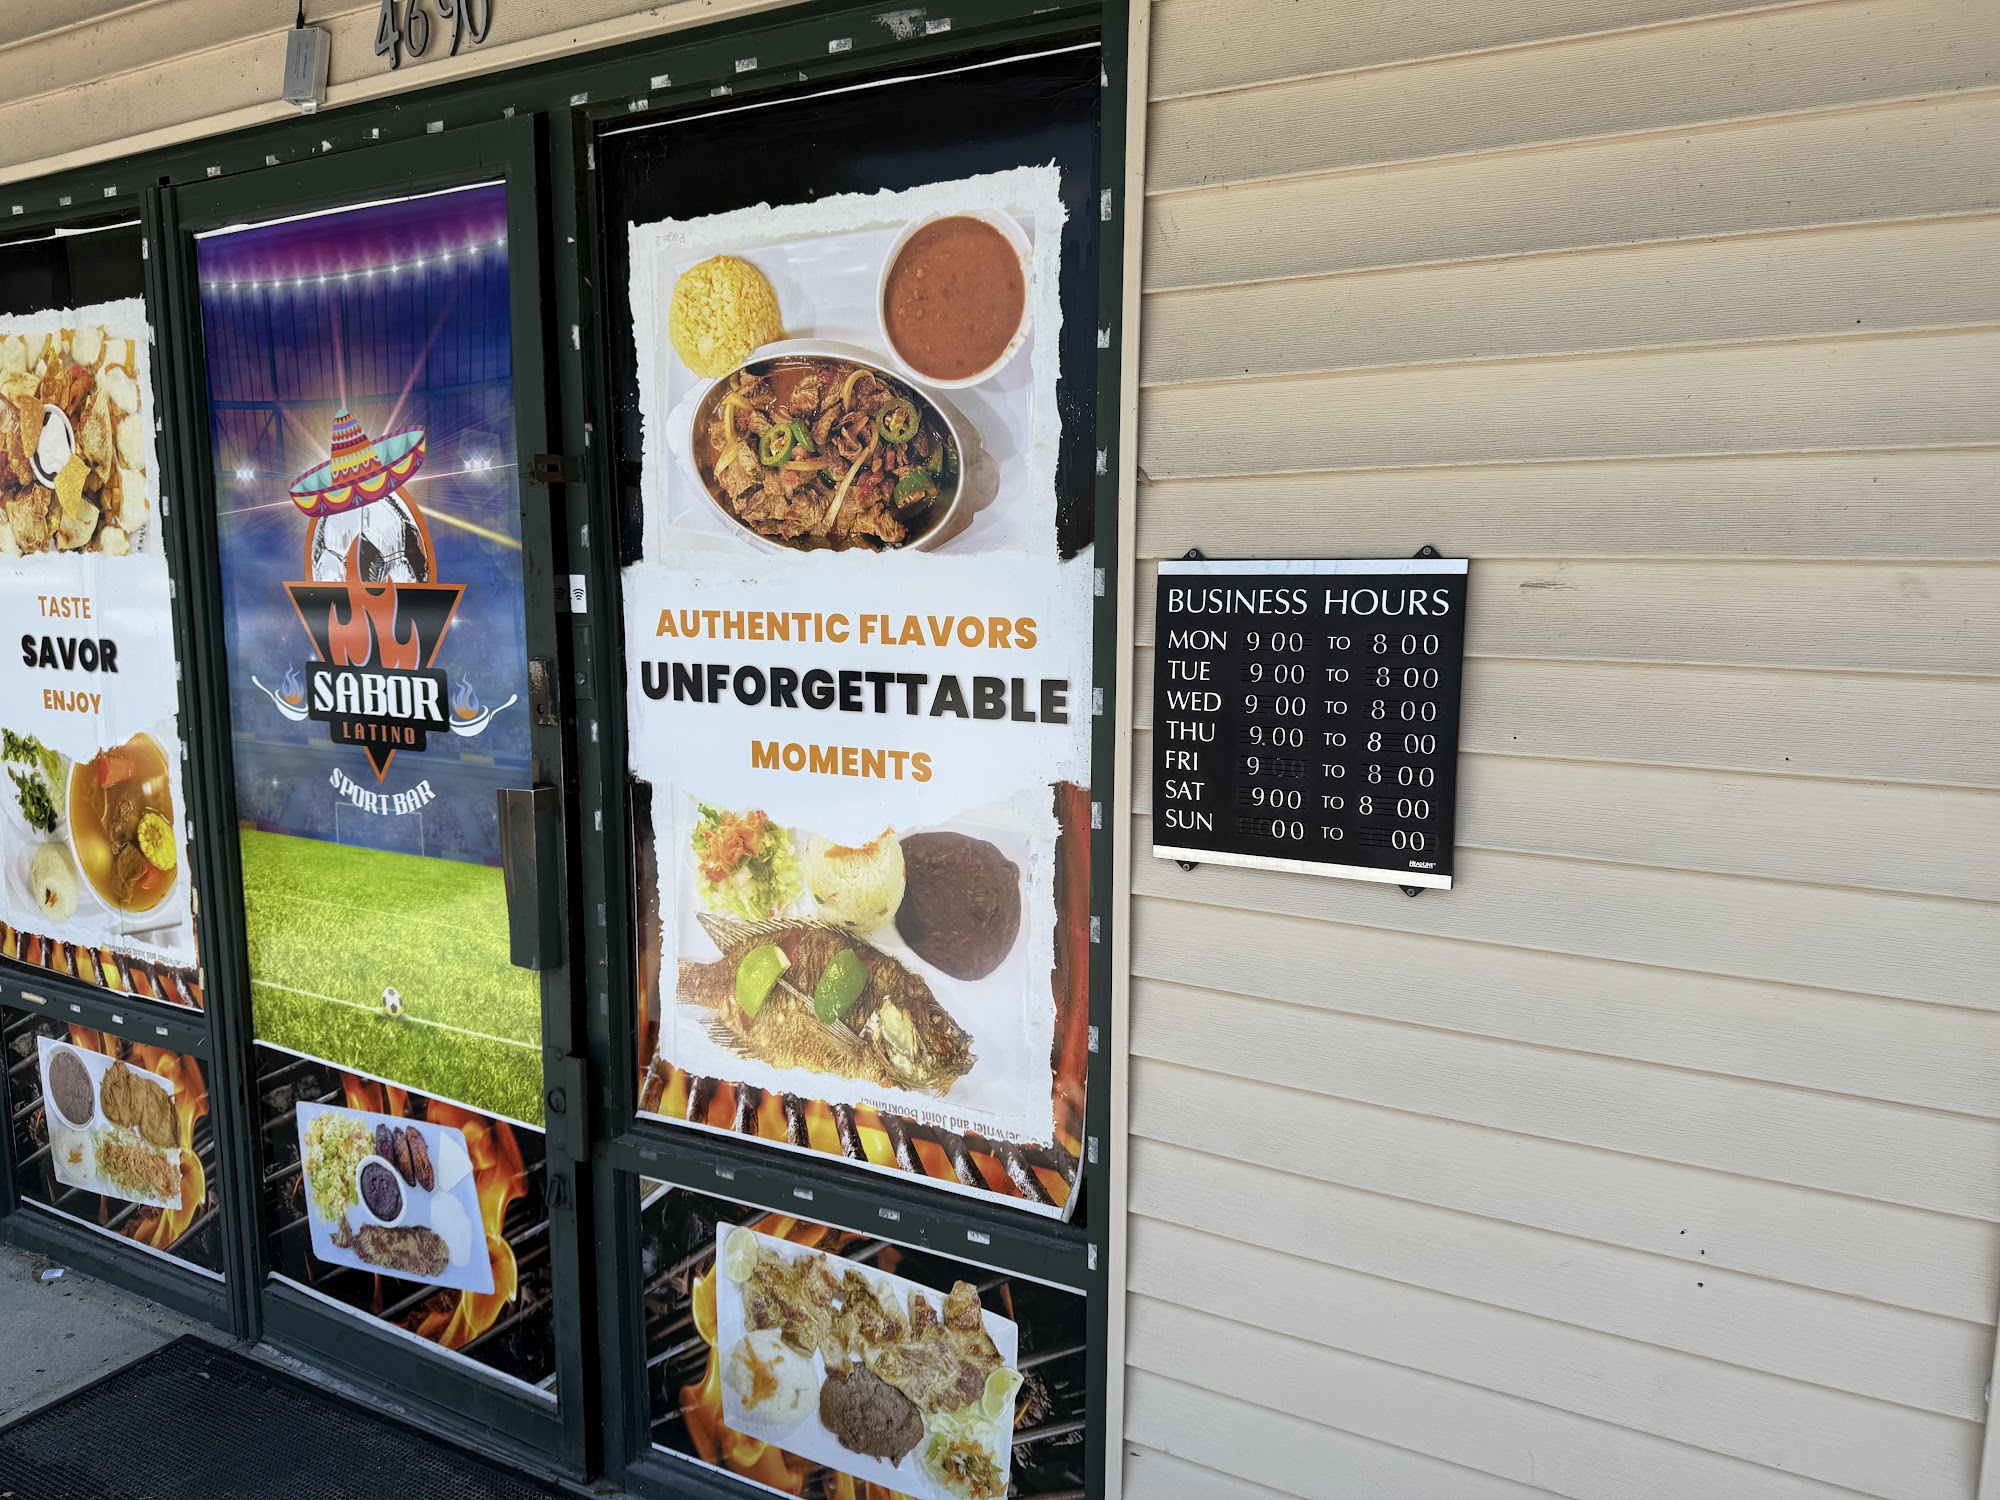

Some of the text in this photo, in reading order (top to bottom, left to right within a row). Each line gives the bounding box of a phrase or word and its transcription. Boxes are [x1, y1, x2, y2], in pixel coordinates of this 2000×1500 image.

[37, 595, 91, 619] TASTE
[1169, 589, 1449, 616] BUSINESS HOURS
[655, 609, 1038, 650] AUTHENTIC FLAVORS
[1169, 630, 1226, 650] MON
[1327, 637, 1350, 649] TO
[21, 634, 119, 673] SAVOR
[1168, 660, 1210, 680] TUE
[1326, 669, 1348, 682] TO
[43, 688, 102, 715] ENJOY
[313, 670, 445, 722] SABOR
[640, 660, 1069, 725] UNFORGETTABLE
[1167, 691, 1221, 711] WED
[1324, 701, 1347, 714] TO
[342, 721, 416, 745] LATINO
[1166, 721, 1215, 742] THU
[1323, 733, 1346, 746] TO
[751, 740, 933, 783] MOMENTS
[1166, 750, 1197, 770] FRI
[1322, 764, 1345, 778] TO
[328, 767, 437, 816] SPORT BAR
[1166, 780, 1205, 800] SAT
[1321, 796, 1344, 809] TO
[1166, 809, 1212, 831] SUN
[1321, 827, 1343, 840] TO
[921, 1109, 946, 1127] Joint
[949, 1116, 970, 1131] and
[973, 1121, 1038, 1142] erwriter
